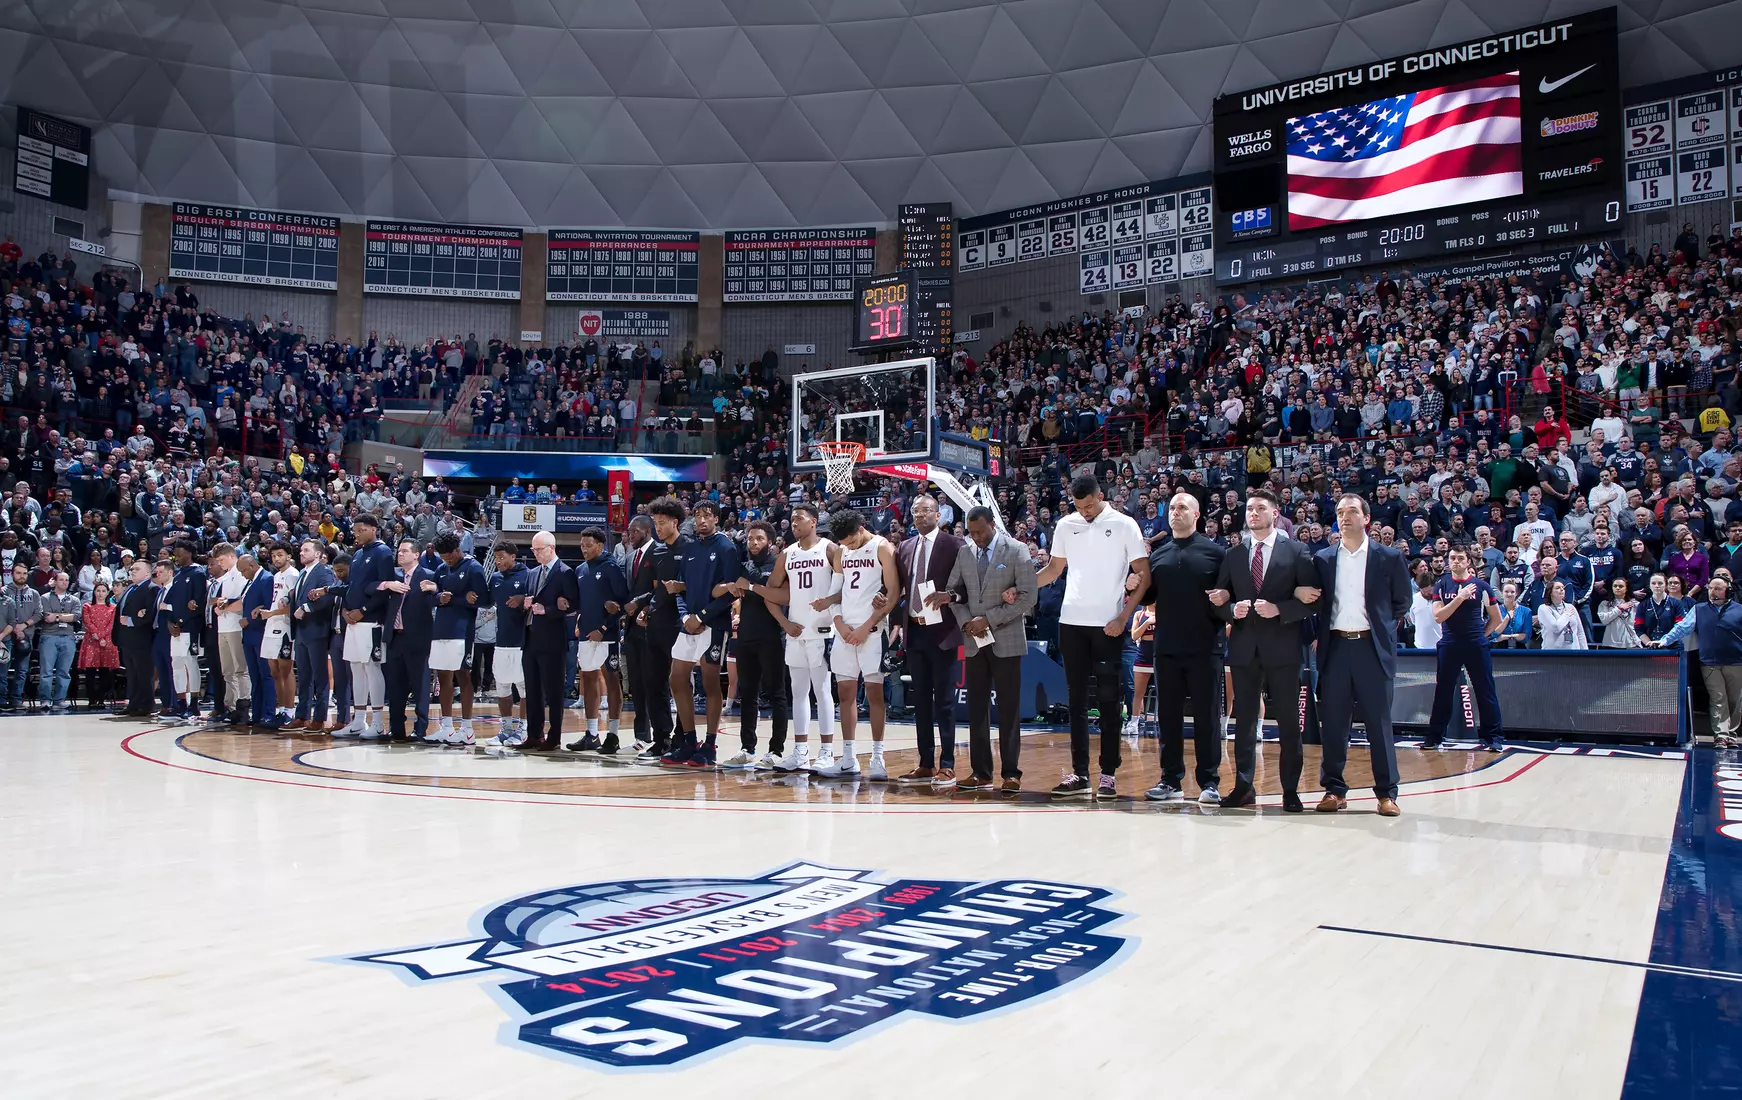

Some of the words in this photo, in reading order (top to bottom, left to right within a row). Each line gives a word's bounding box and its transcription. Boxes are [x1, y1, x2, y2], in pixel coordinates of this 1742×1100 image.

[1243, 71, 1362, 111] UNIVERSITY
[1369, 62, 1396, 81] OF
[1403, 24, 1572, 74] CONNECTICUT
[1695, 96, 1706, 104] JIM
[1556, 112, 1598, 126] DUNKIN'
[1556, 120, 1598, 133] DONUTS
[1228, 129, 1272, 146] WELLS
[1632, 125, 1665, 148] 52
[1229, 141, 1272, 158] FARGO
[1539, 164, 1592, 180] TRAVELERS
[1641, 180, 1658, 200] 15
[1692, 171, 1712, 192] 22
[1010, 207, 1042, 218] UCONN
[1047, 197, 1090, 211] HUSKIES
[1097, 194, 1109, 202] OF
[1115, 186, 1150, 199] HONOR
[177, 205, 200, 214] BIG
[207, 208, 241, 218] EAST
[250, 212, 336, 227] CONFERENCE
[1184, 207, 1208, 224] 42
[1232, 208, 1267, 224] CBS
[1437, 216, 1459, 226] BONUS
[1472, 212, 1489, 221] POSS
[1606, 202, 1619, 222] 0
[177, 216, 224, 225] REGULAR
[230, 220, 270, 229] SEASON
[276, 225, 335, 235] CHAMPIONS
[1084, 225, 1106, 242] 42
[1116, 219, 1139, 236] 44
[1380, 224, 1424, 245] 20:00
[200, 227, 217, 238] 1994
[318, 238, 336, 248] 2002
[382, 233, 447, 242] TOURNAMENT
[452, 237, 508, 245] CHAMPIONS
[734, 232, 766, 241] NCAA
[773, 230, 867, 240] CHAMPIONSHIP
[1052, 231, 1073, 248] 25
[1320, 236, 1335, 244] POSS
[1347, 231, 1367, 240] BONUS
[1445, 240, 1457, 249] TM
[1459, 238, 1474, 247] FLS
[1478, 235, 1485, 245] 0
[1496, 232, 1507, 241] 30
[1509, 230, 1526, 239] SEC
[1528, 228, 1534, 238] 3
[1548, 223, 1568, 234] FULL
[87, 244, 104, 254] 212
[174, 241, 192, 252] 2003
[199, 243, 217, 254] 2005
[480, 248, 497, 258] 2004
[503, 249, 519, 259] 2011
[998, 243, 1005, 257] 9
[1022, 237, 1042, 254] 22
[966, 248, 978, 263] C
[1119, 263, 1137, 280] 13
[1151, 257, 1173, 275] 22
[1231, 260, 1241, 277] 0
[1256, 268, 1272, 276] FULL
[1283, 264, 1288, 273] 3
[1290, 263, 1298, 271] 30
[1301, 261, 1315, 270] SEC
[1328, 258, 1333, 266] 0
[1335, 256, 1346, 264] TM
[1348, 254, 1361, 262] FLS
[1417, 269, 1439, 279] Harry
[1441, 268, 1450, 276] A.
[1452, 264, 1484, 274] Gampel
[1487, 259, 1519, 270] Pavilion
[1528, 254, 1556, 264] Storrs,
[175, 270, 239, 281] CONNECTICUT
[244, 276, 270, 284] MEN'S
[275, 279, 332, 288] BASKETBALL
[1084, 268, 1106, 286] 24
[369, 285, 428, 294] CONNECTICUT
[462, 290, 515, 298] BASKETBALL
[865, 284, 906, 306] 20:00
[641, 328, 668, 336] CHAMPION
[870, 306, 901, 340] 30
[965, 332, 979, 340] 213
[1621, 462, 1632, 470] 34
[866, 498, 881, 506] 113
[788, 559, 824, 570] UCONN
[842, 559, 874, 568] UCONN
[798, 571, 812, 589] 10
[850, 571, 860, 589] 2
[1460, 684, 1474, 728] UCONN
[773, 883, 859, 911] MEN'S
[884, 884, 941, 905] 1999
[571, 891, 749, 932] UCONN
[808, 908, 887, 932] 2004
[532, 908, 784, 964] BASKETBALL
[697, 936, 799, 963] 2011
[550, 882, 1095, 1057] CHAMPIONS
[937, 940, 1098, 1005] FOUR-TIME
[545, 964, 677, 995] 2014
[818, 949, 1008, 1016] NATIONAL
